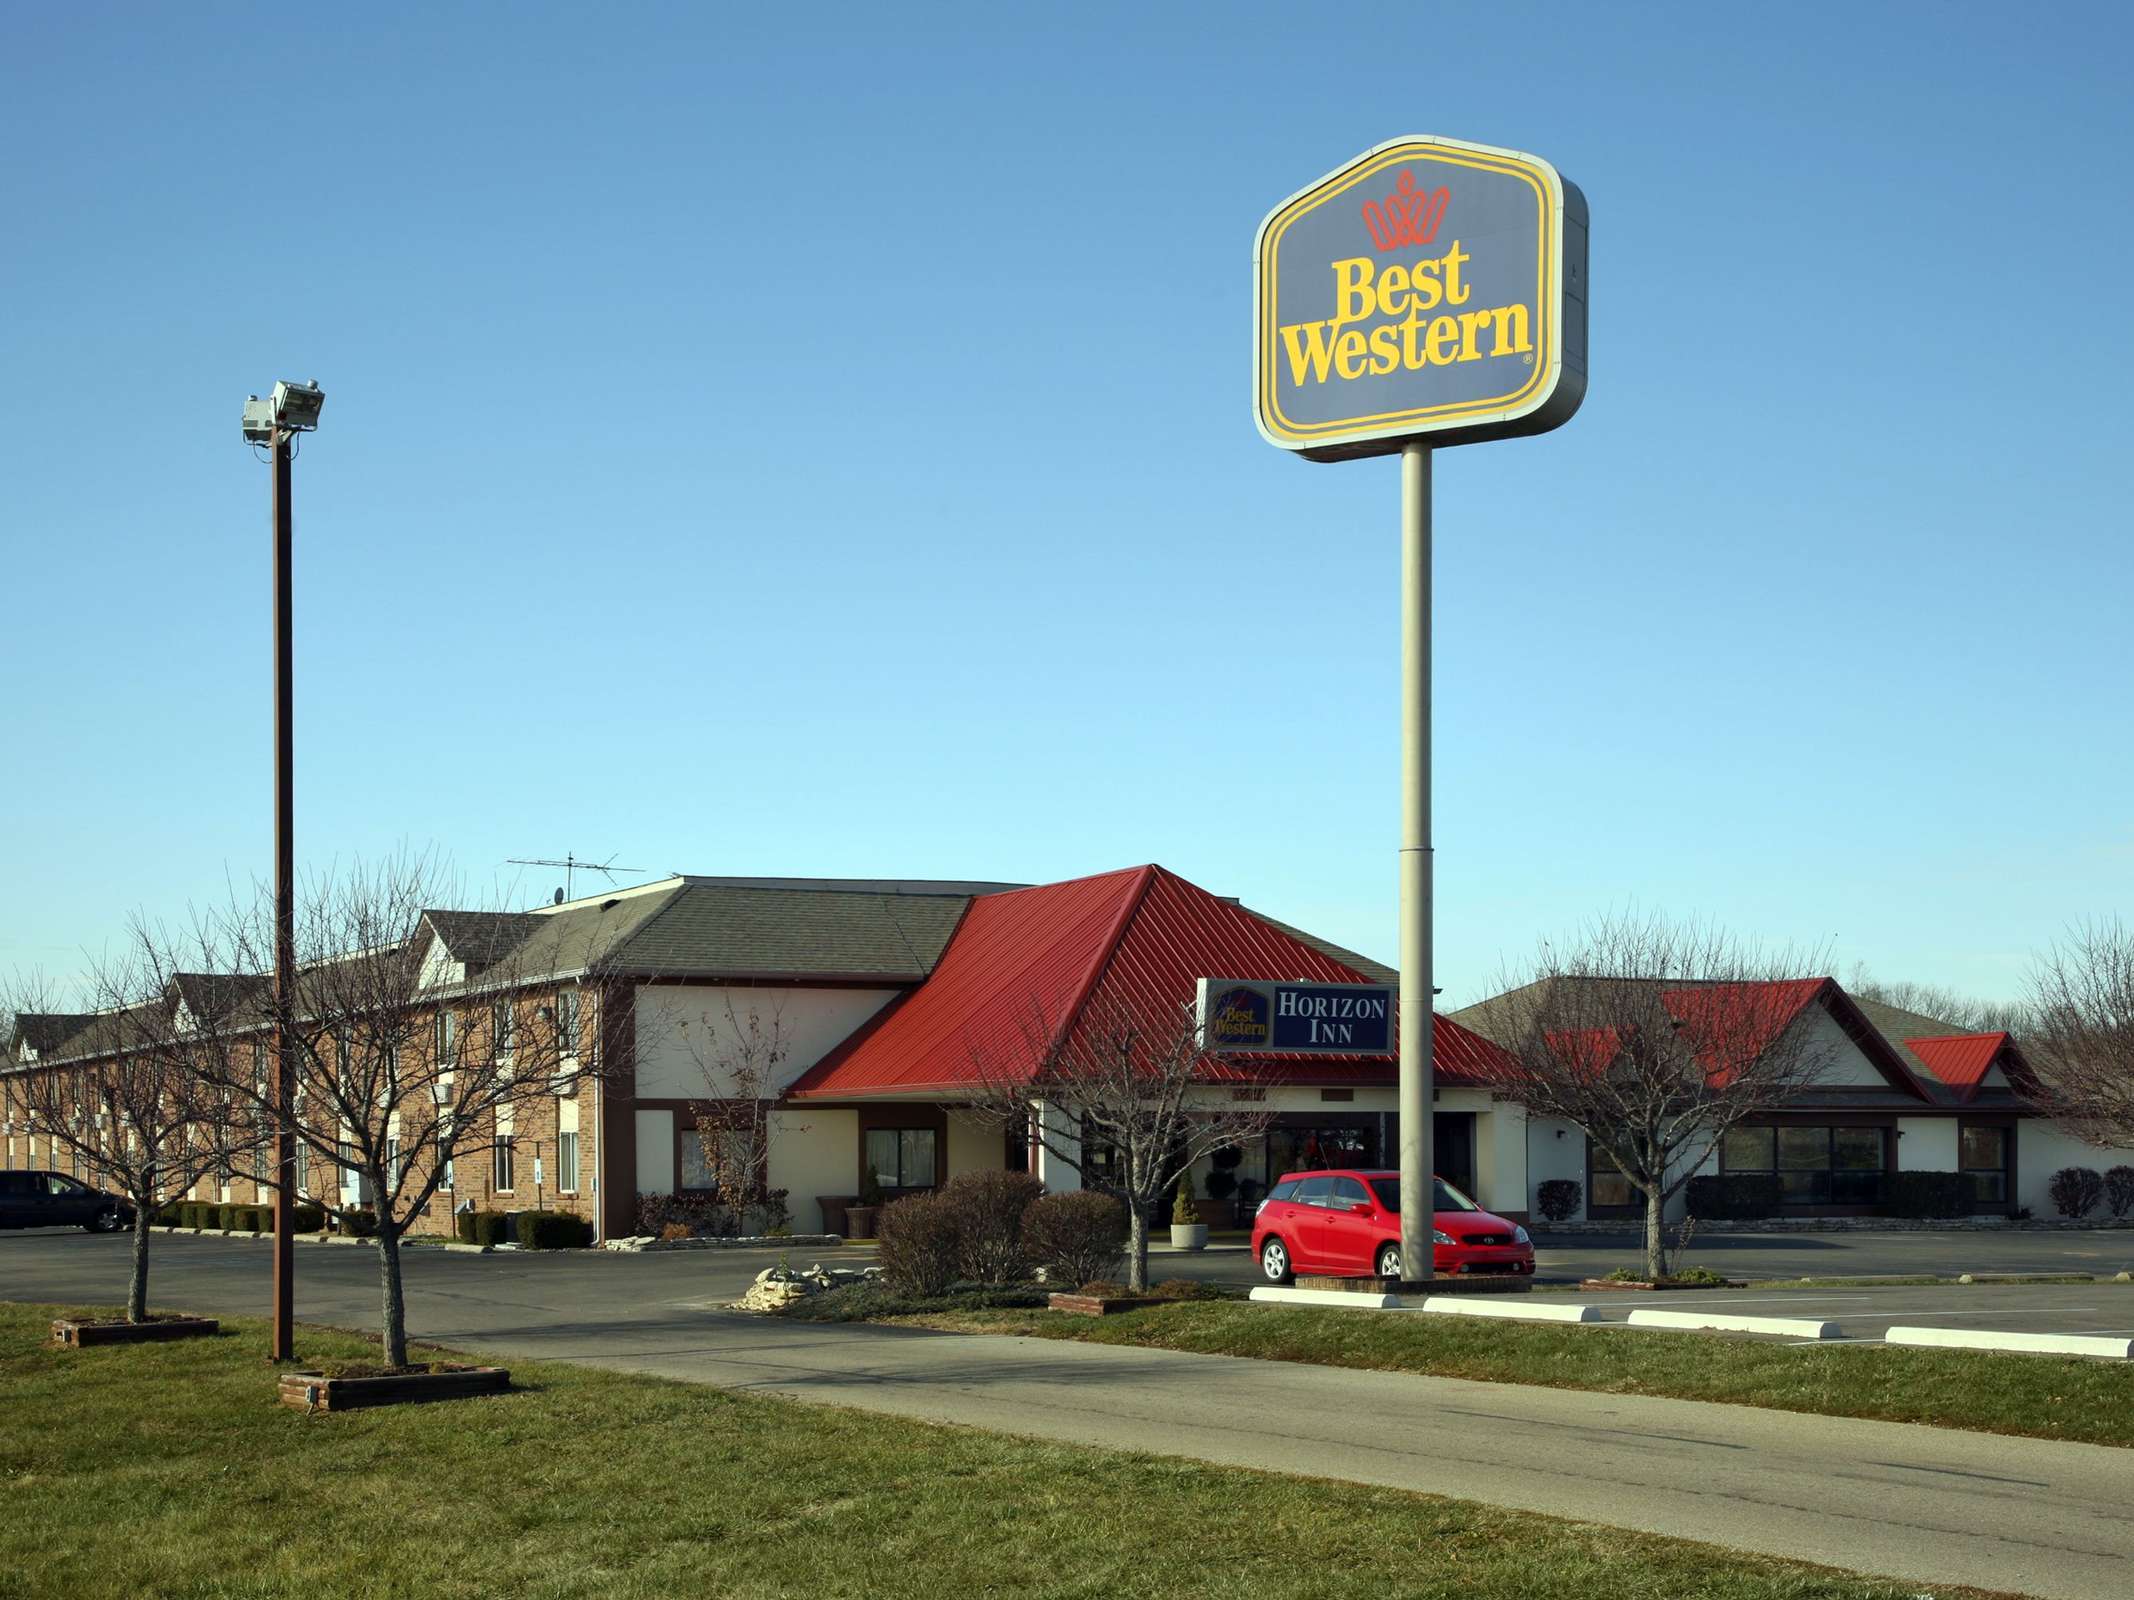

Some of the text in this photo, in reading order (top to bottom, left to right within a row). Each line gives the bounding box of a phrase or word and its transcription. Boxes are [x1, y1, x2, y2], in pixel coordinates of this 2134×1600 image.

[1331, 239, 1470, 325] Best
[1279, 292, 1533, 387] Western
[1226, 1007, 1255, 1023] Best
[1278, 991, 1385, 1019] HORIZON
[1216, 1019, 1266, 1036] Western
[1309, 1019, 1353, 1044] INN
